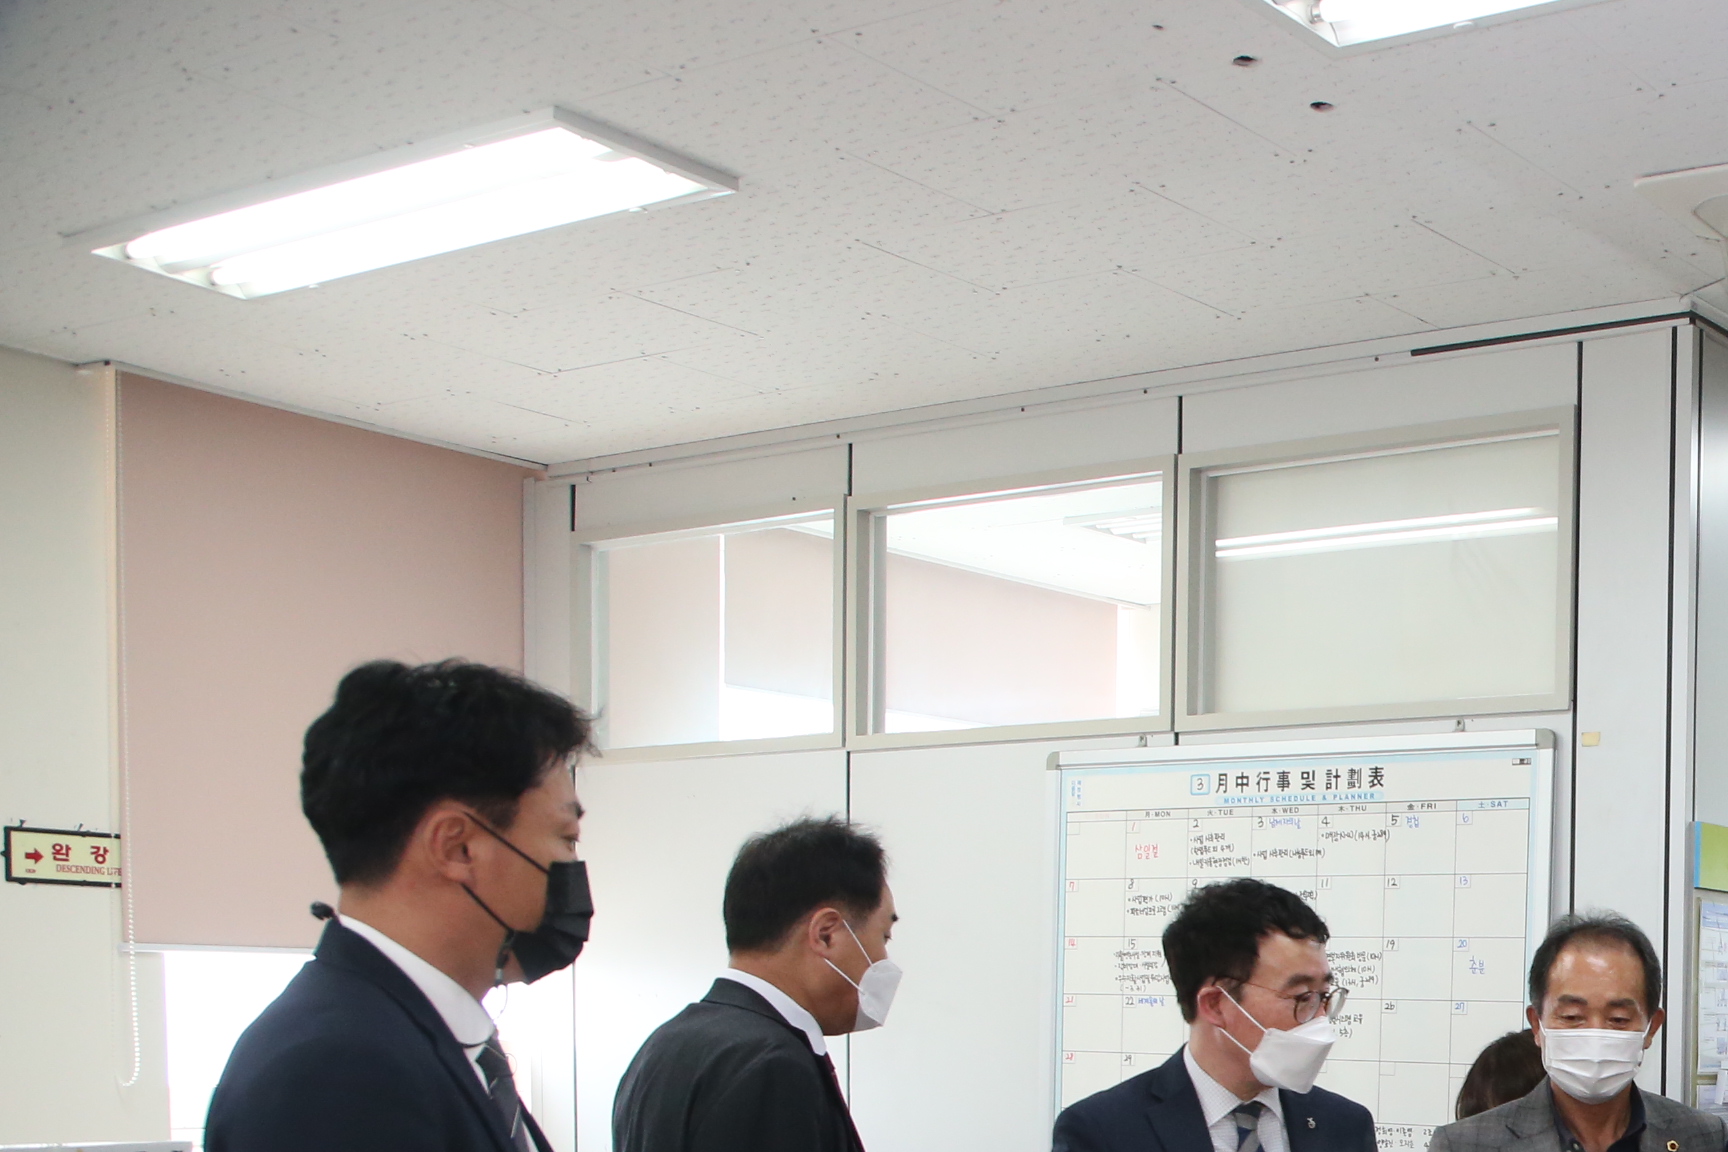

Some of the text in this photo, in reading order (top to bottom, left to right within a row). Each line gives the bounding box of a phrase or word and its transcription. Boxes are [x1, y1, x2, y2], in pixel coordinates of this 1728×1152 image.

[1300, 770, 1316, 791] 및
[1325, 766, 1386, 791] 計劃表
[1270, 795, 1316, 803] SCHEDULE
[1193, 818, 1200, 828] 2
[1257, 816, 1264, 828] 3
[1322, 816, 1330, 826] 4
[1390, 814, 1400, 826] 5
[1462, 813, 1469, 824] 6
[56, 864, 105, 876] DESCENDING
[1128, 878, 1134, 890] 8
[1386, 878, 1398, 888] 12
[1459, 876, 1468, 886] 13
[1128, 938, 1136, 950] 15
[1386, 939, 1396, 949] 19
[1456, 939, 1468, 948] 20
[1469, 955, 1486, 974] 춘분
[1125, 996, 1135, 1006] 22
